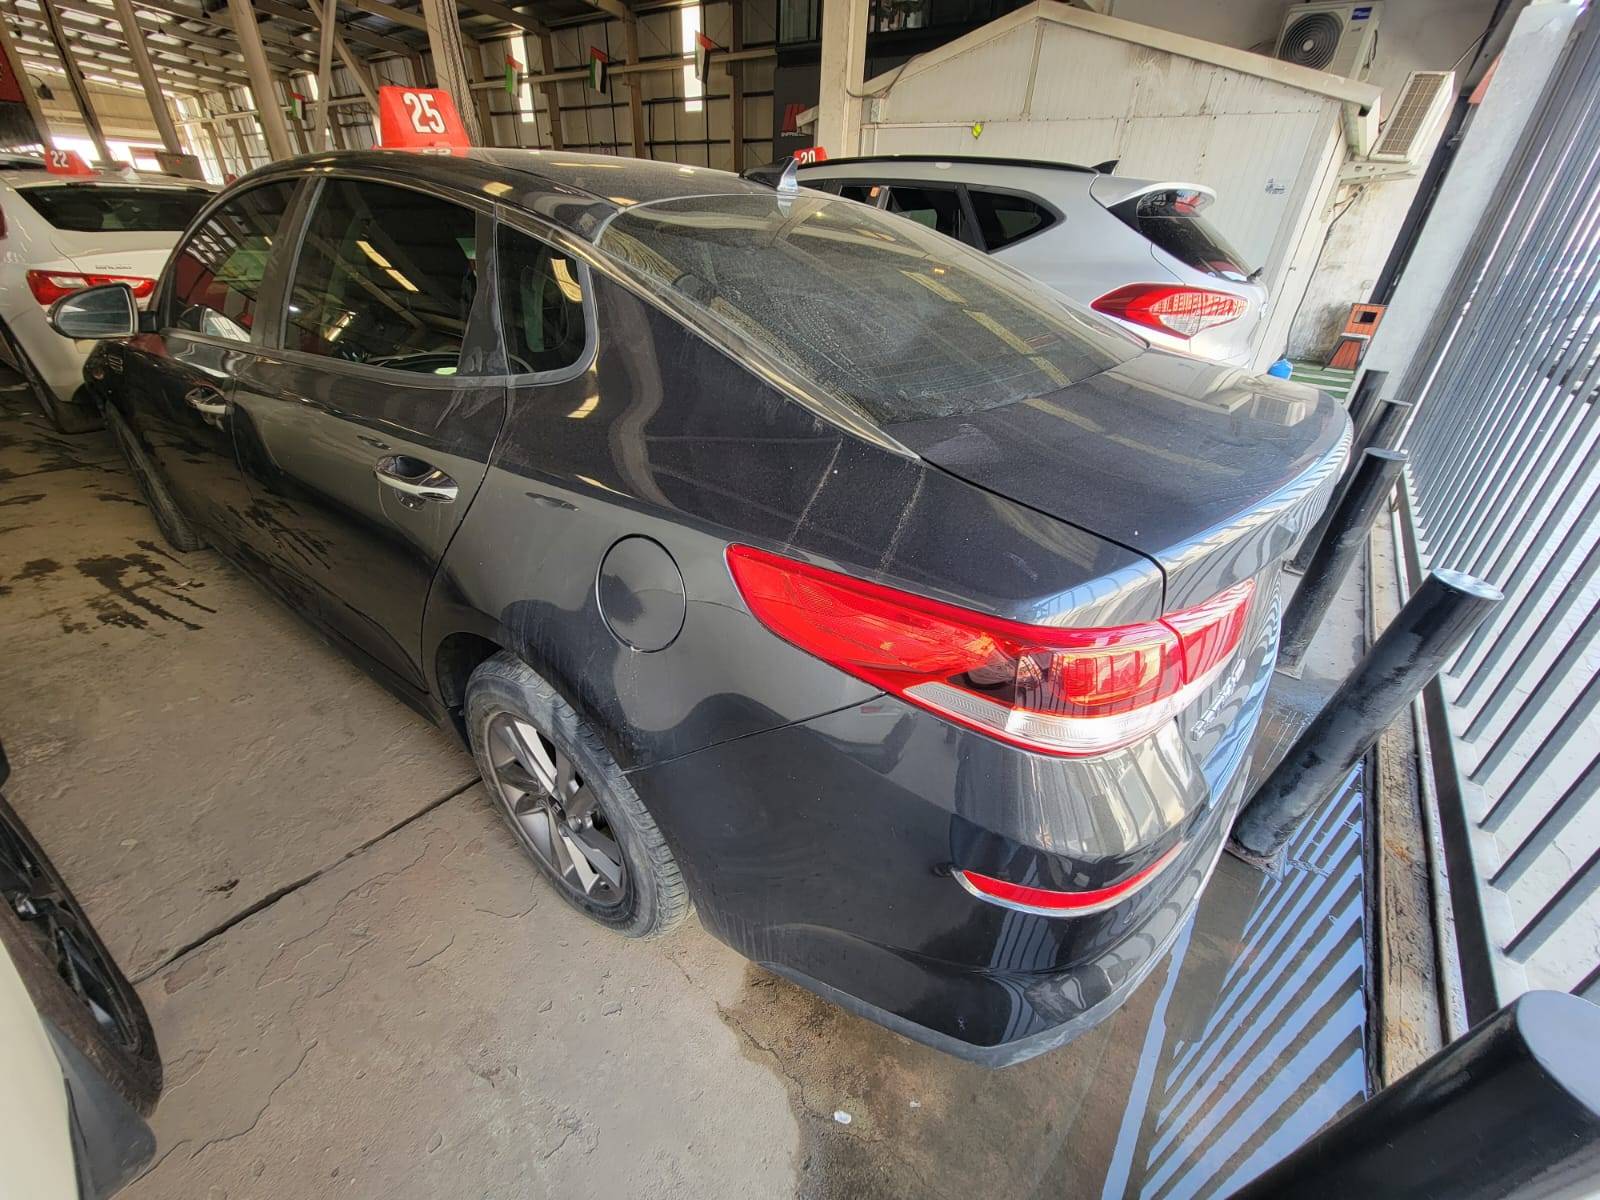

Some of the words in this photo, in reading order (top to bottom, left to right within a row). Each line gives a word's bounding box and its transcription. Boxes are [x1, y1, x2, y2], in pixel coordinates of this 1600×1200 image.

[402, 92, 446, 134] 25
[50, 150, 70, 168] 22
[800, 150, 816, 165] 20
